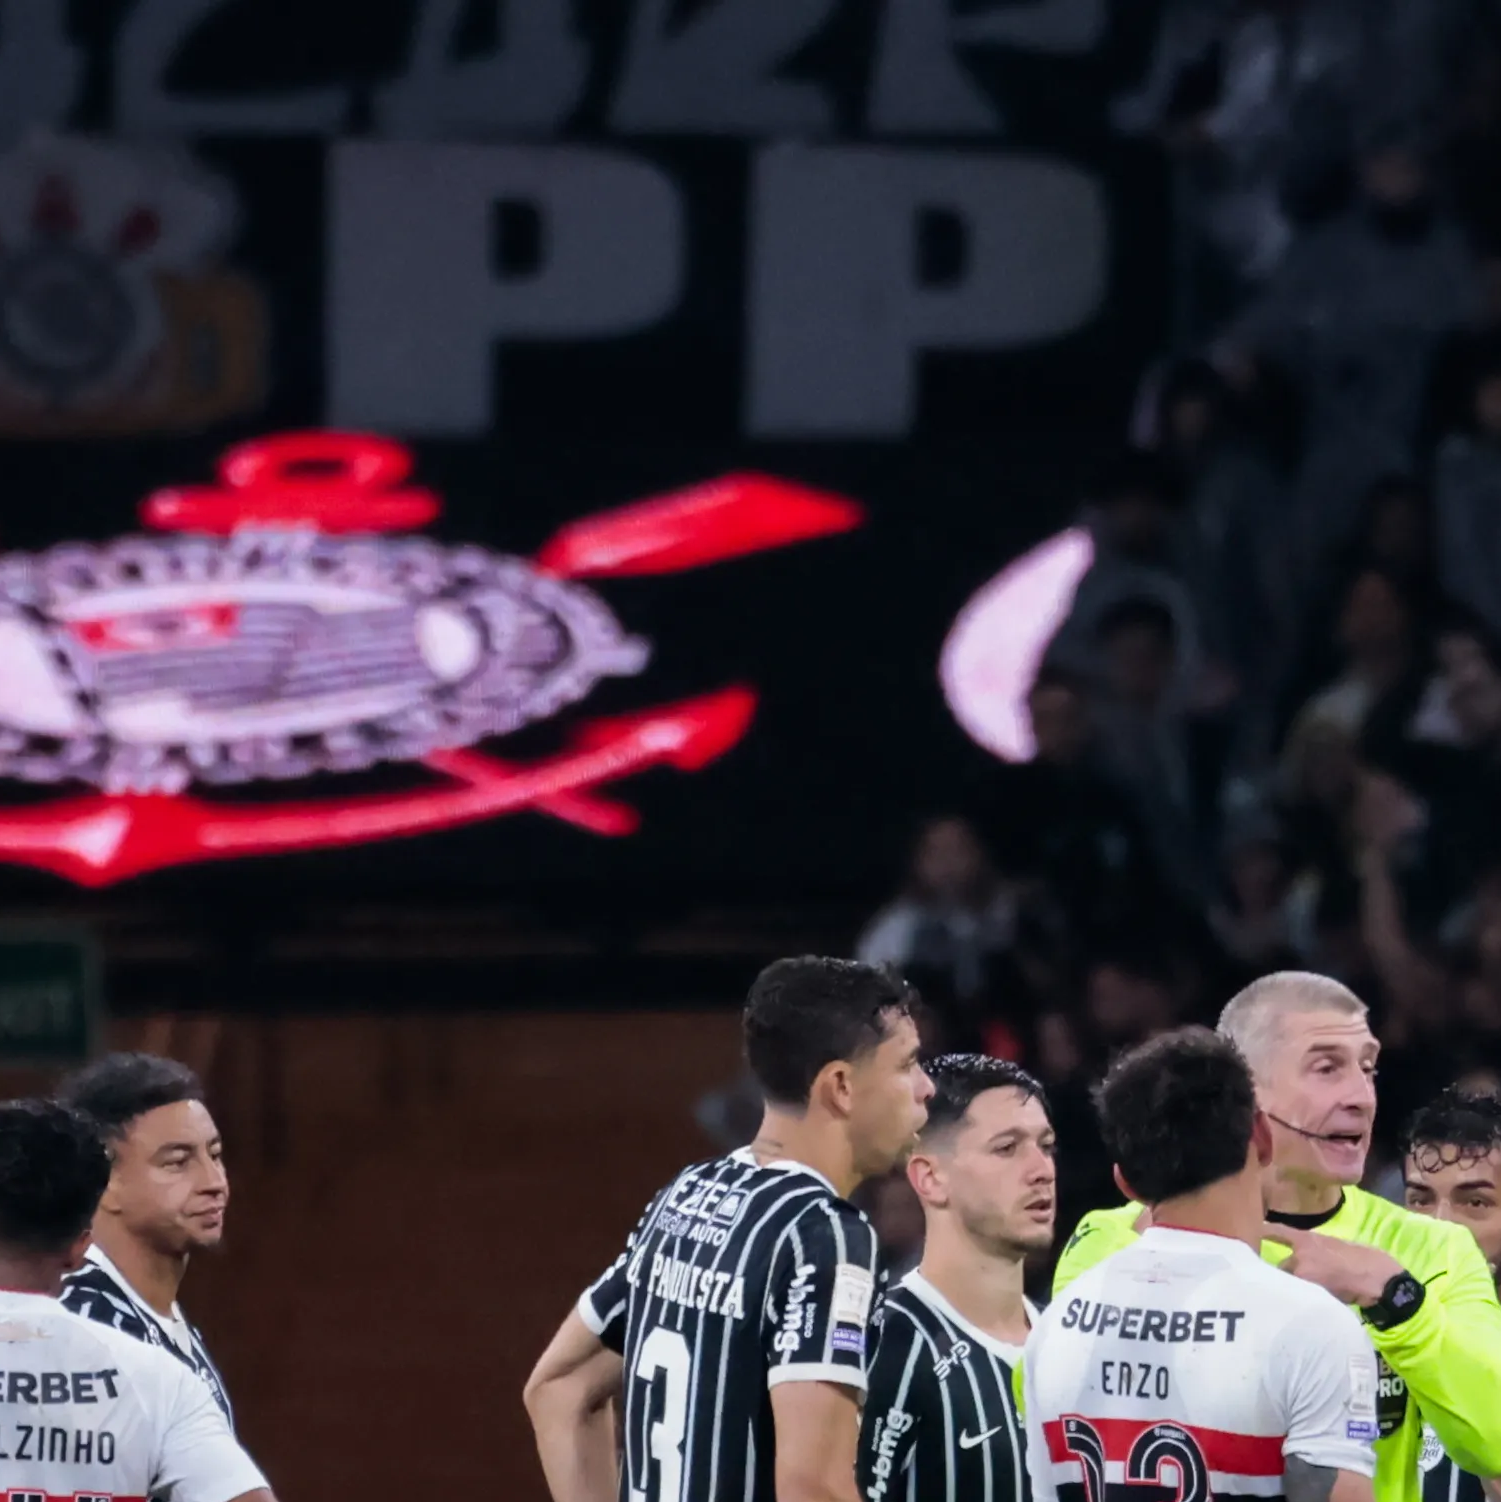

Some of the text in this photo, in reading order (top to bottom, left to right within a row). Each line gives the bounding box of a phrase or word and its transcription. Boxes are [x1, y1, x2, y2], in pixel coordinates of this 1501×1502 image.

[687, 1222, 727, 1247] AUTO
[648, 1252, 745, 1320] PAULISTA
[774, 1284, 816, 1352] bmg
[804, 1303, 817, 1338] banco
[1061, 1297, 1245, 1343] SUPERBET
[933, 1340, 971, 1382] BYD
[1101, 1360, 1170, 1400] ENZO
[872, 1407, 914, 1479] bmg
